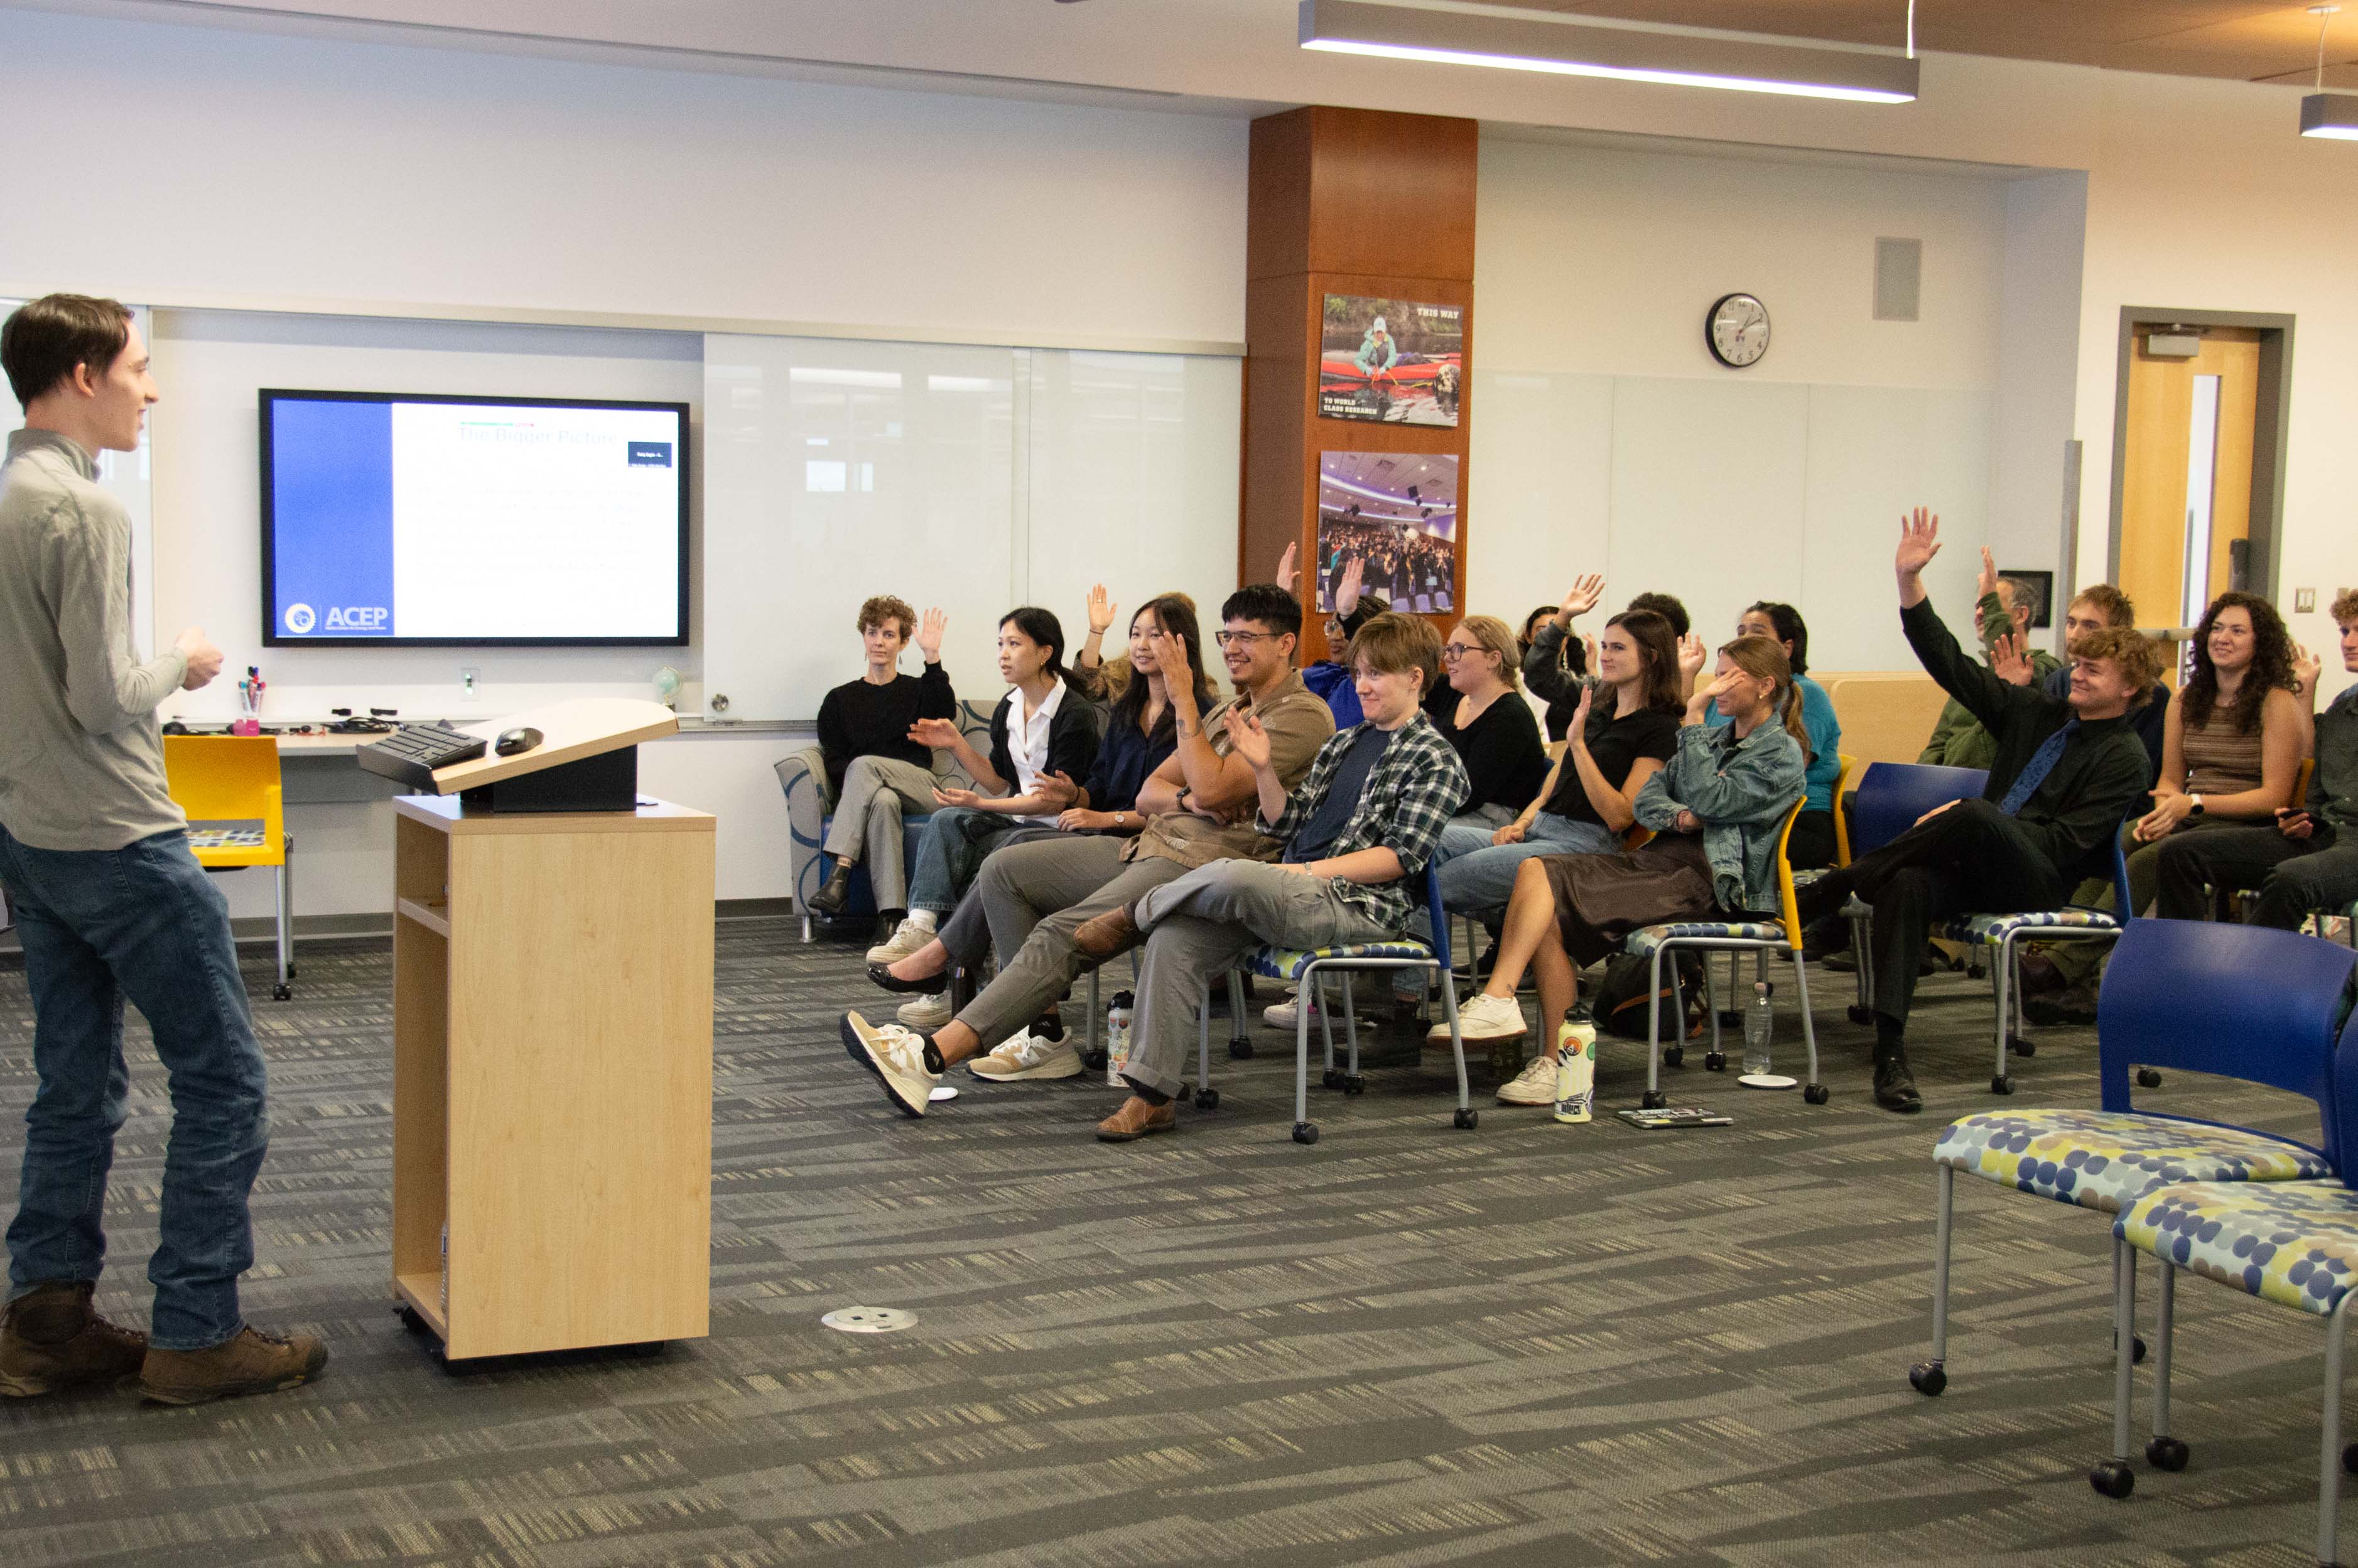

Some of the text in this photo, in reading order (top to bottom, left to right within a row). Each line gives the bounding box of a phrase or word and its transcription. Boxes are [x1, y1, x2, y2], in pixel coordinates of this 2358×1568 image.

[1417, 308, 1459, 319] THIS WAY
[1344, 406, 1377, 414] RESEARCH
[459, 427, 617, 446] The Bigger Picture
[325, 607, 388, 626] ACEP
